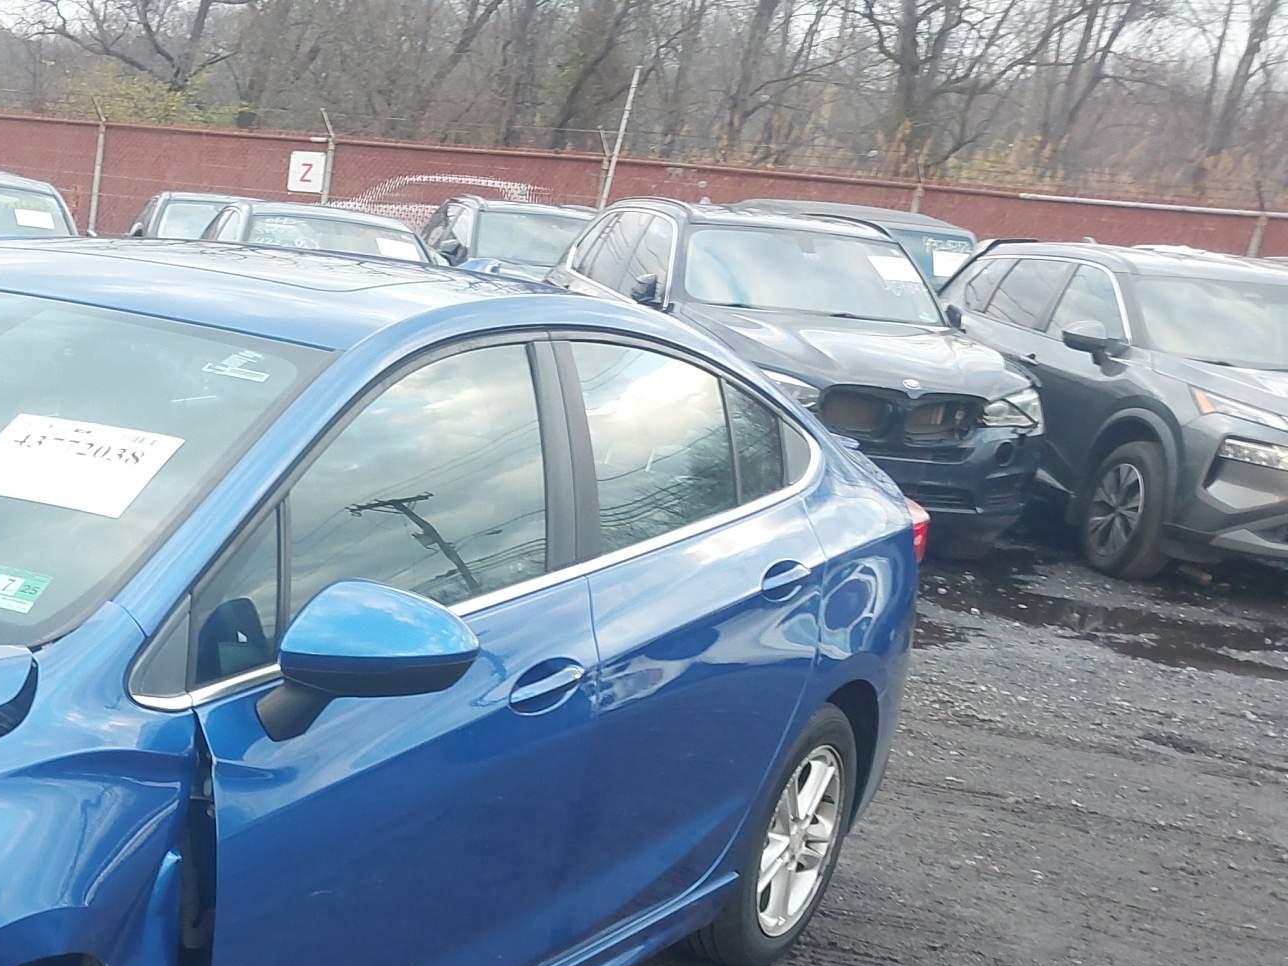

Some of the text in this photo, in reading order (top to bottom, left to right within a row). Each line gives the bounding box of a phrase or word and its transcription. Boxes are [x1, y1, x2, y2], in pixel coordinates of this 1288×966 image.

[299, 163, 313, 183] Z
[3, 578, 16, 591] 7
[20, 584, 40, 595] 25
